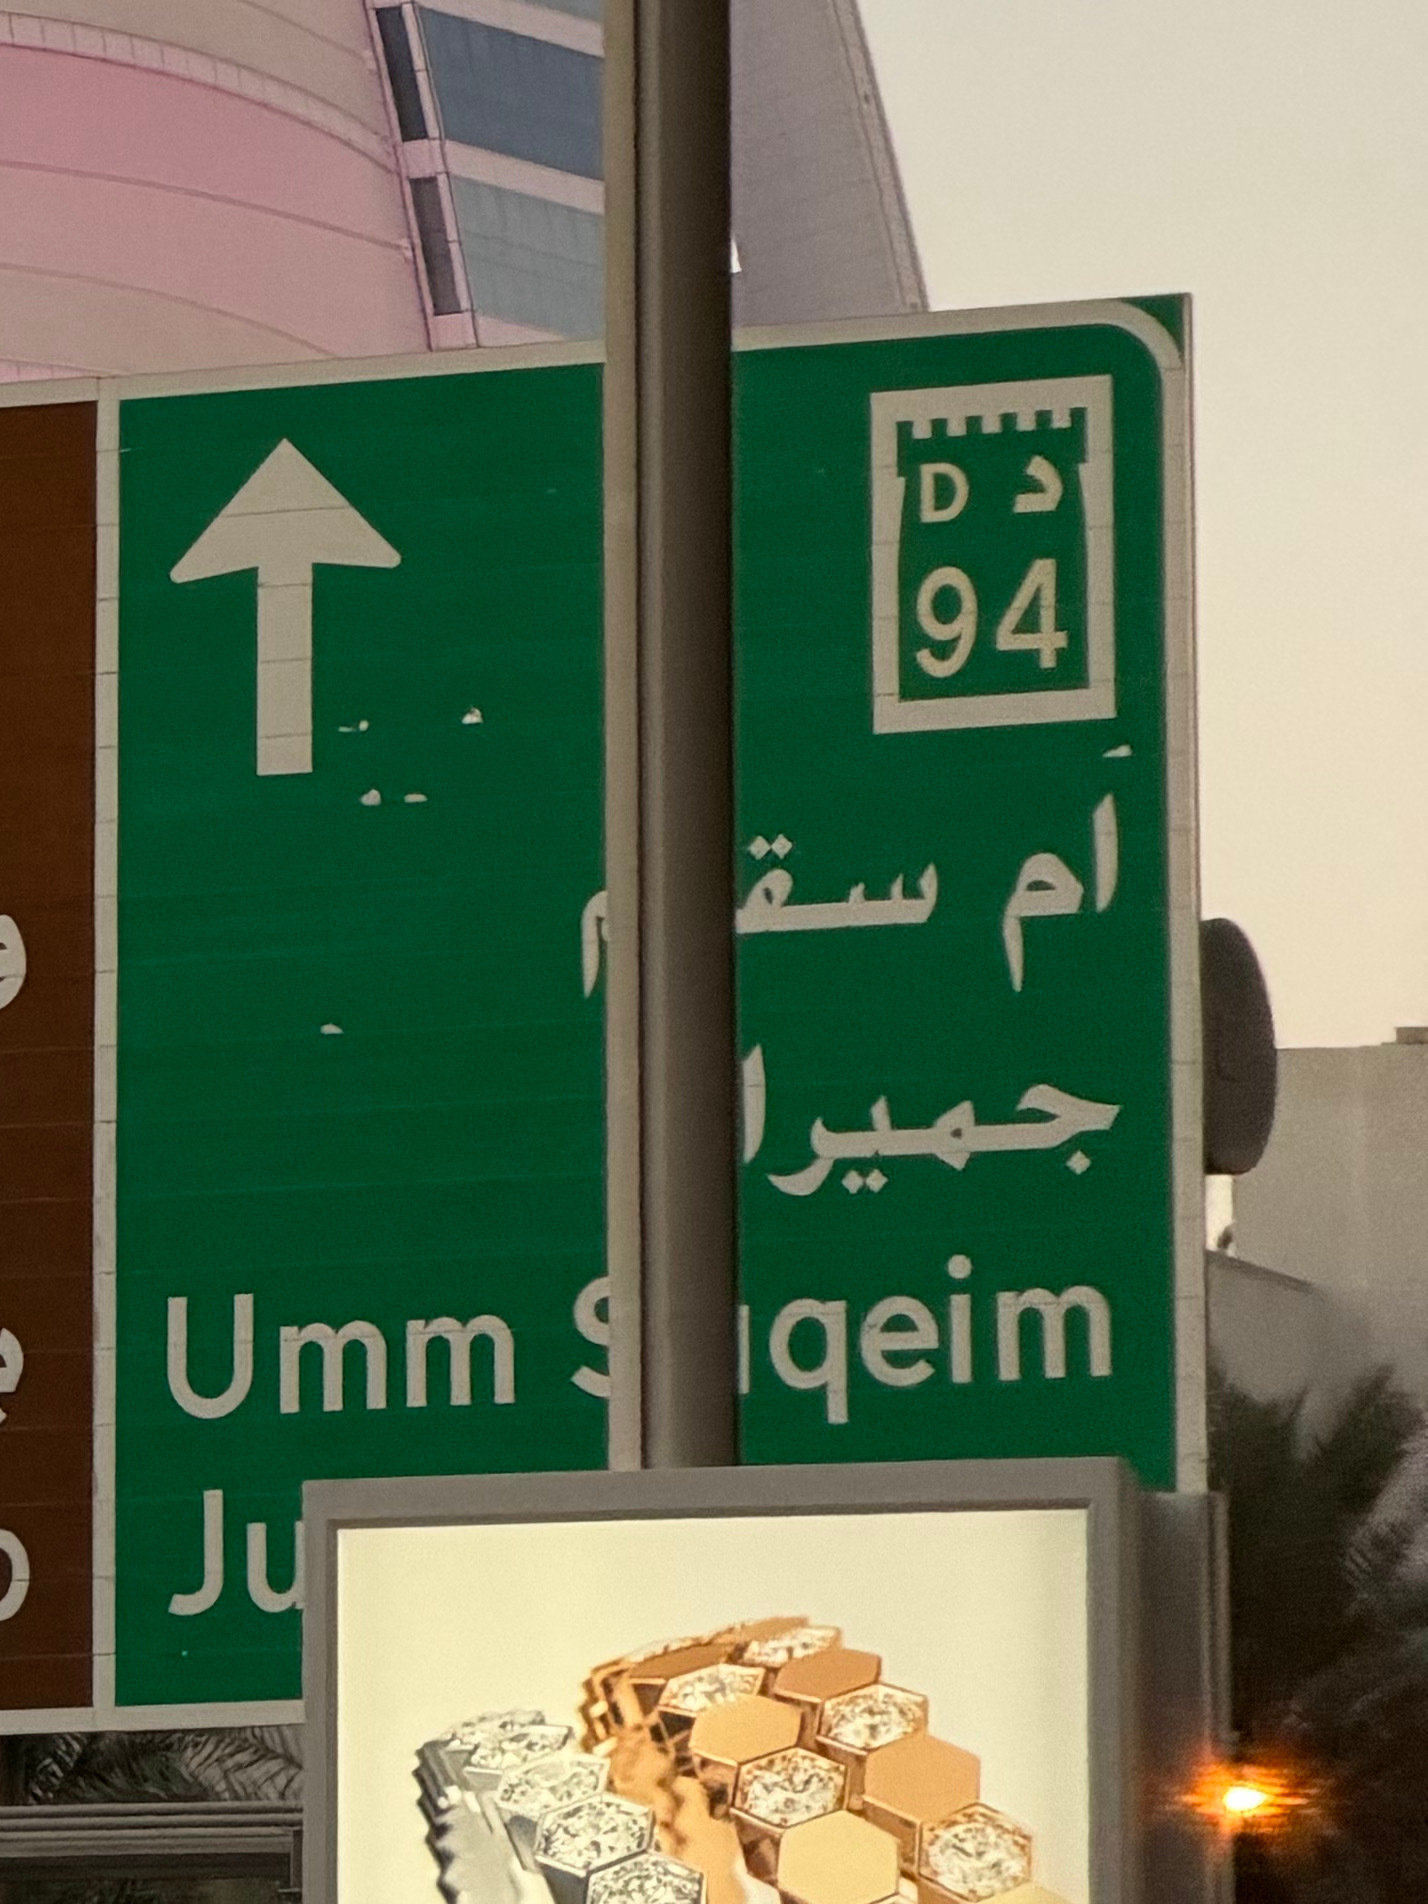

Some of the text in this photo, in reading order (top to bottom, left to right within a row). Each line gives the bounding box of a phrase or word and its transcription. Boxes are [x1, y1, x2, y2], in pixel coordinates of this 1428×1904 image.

[919, 462, 969, 523] D
[1012, 455, 1063, 514] د
[915, 558, 1068, 679] 94
[741, 1044, 1121, 1196] جميرا
[167, 1254, 1112, 1425] Umm qeim
